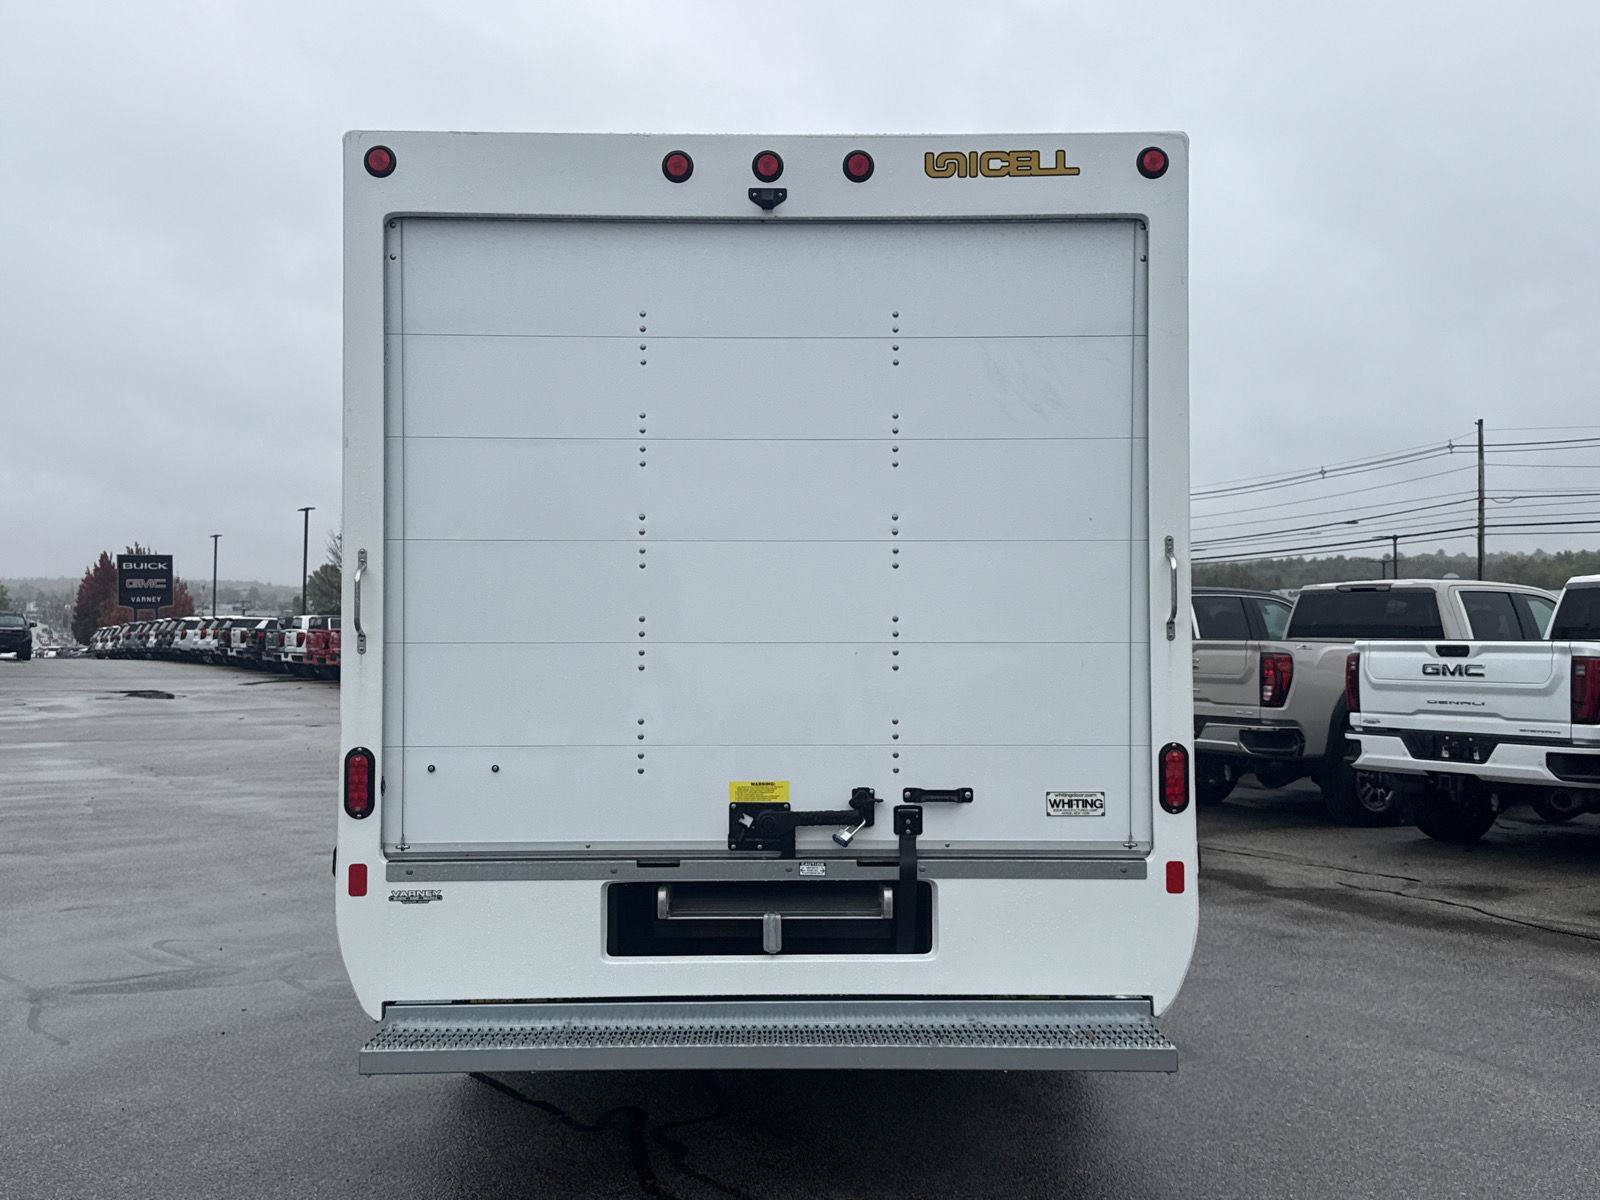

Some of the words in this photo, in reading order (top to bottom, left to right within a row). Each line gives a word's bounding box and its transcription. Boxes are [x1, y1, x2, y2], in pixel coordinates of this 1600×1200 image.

[924, 150, 1080, 178] UNICELL
[122, 562, 168, 570] BUICK
[125, 578, 167, 589] GMC
[1422, 663, 1485, 677] GMC
[1048, 799, 1104, 808] WHITING
